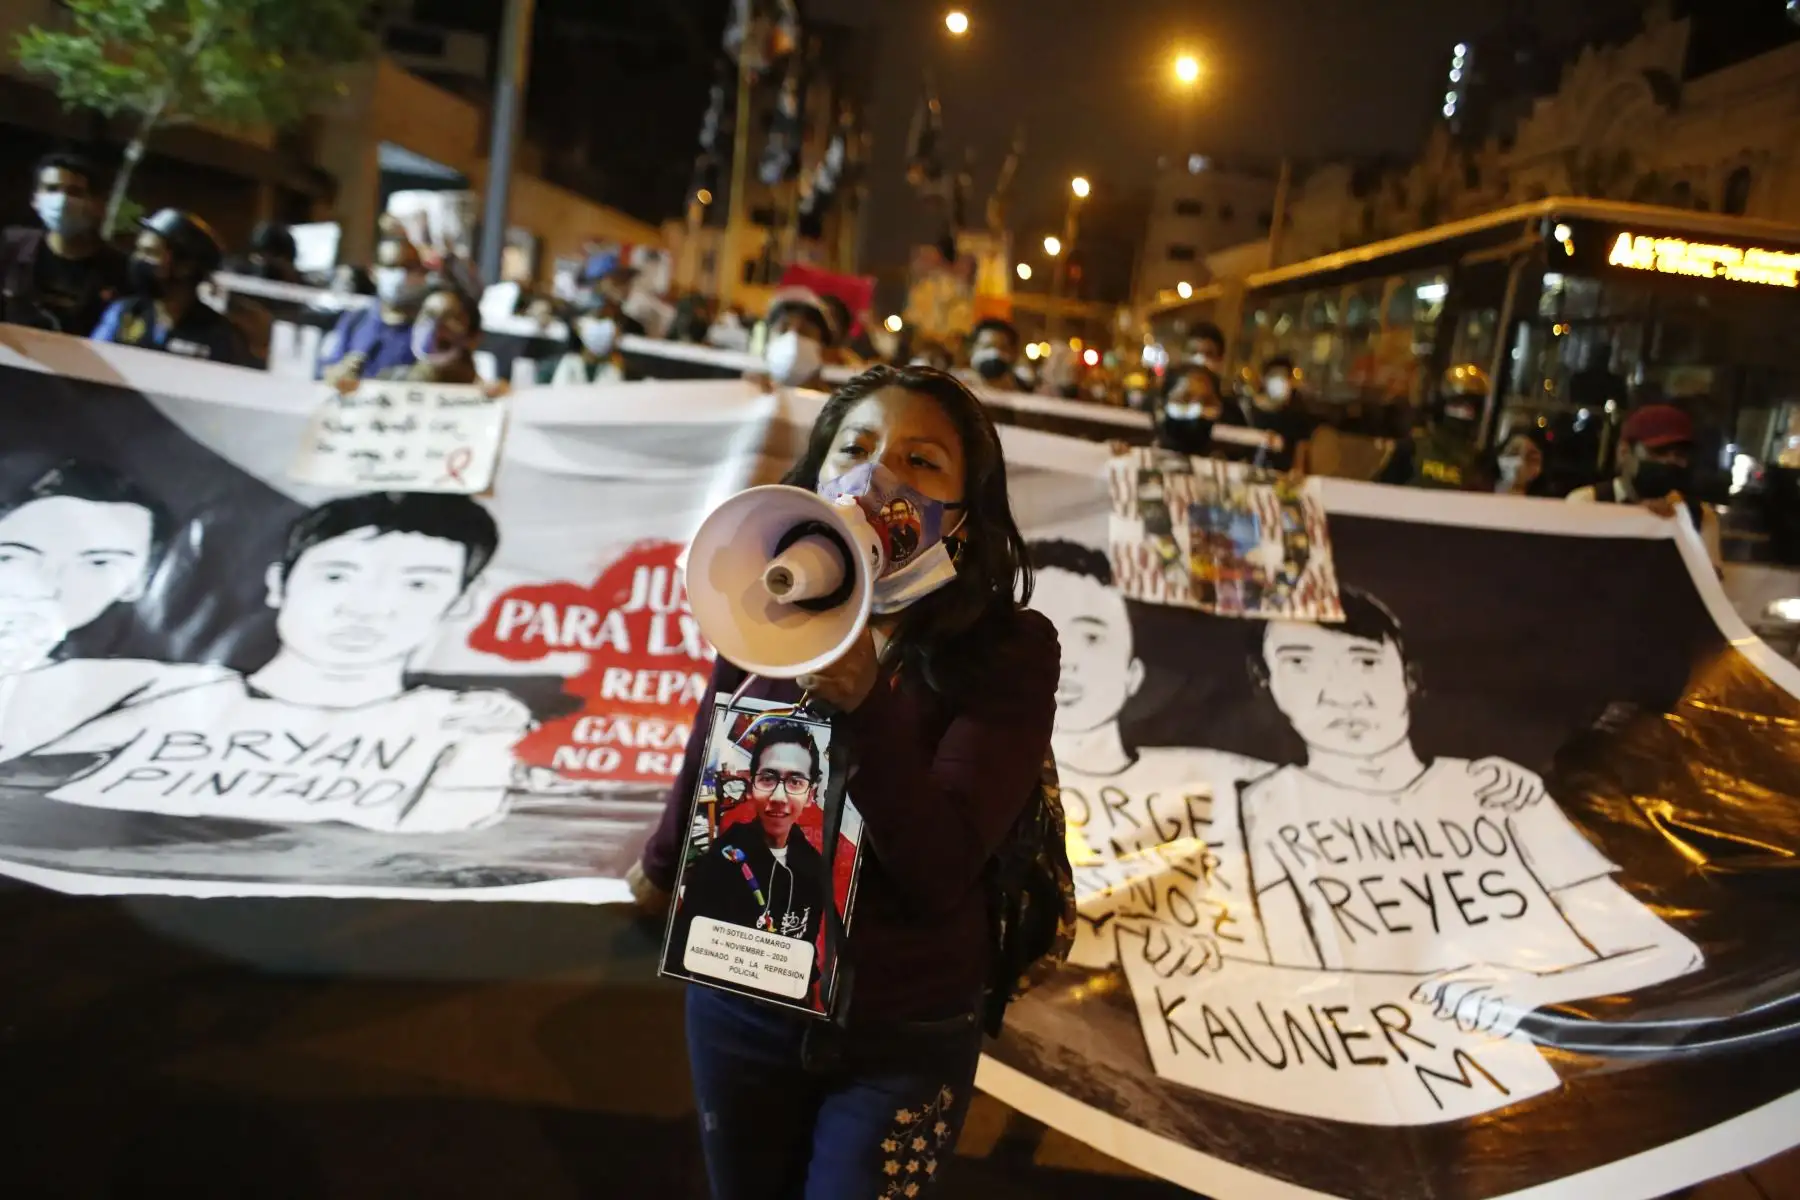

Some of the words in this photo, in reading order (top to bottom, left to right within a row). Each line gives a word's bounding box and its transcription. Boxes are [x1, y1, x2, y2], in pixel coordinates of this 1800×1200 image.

[623, 565, 692, 614] JU
[495, 598, 631, 654] PARA
[149, 730, 416, 772] BRYAN
[552, 746, 620, 773] NO
[102, 765, 405, 808] PINTADO
[1278, 815, 1508, 868] REYNALDO
[1308, 869, 1528, 943] REYES
[690, 946, 729, 961] ASESINADO
[734, 956, 744, 965] EN
[749, 961, 759, 969] LA
[725, 942, 765, 957] NOVIEMBRE
[772, 953, 788, 963] 2020
[726, 927, 753, 941] SOTELO
[755, 935, 791, 950] CAMARGO
[728, 965, 759, 980] POLICIAL
[1154, 986, 1436, 1071] KAUNER
